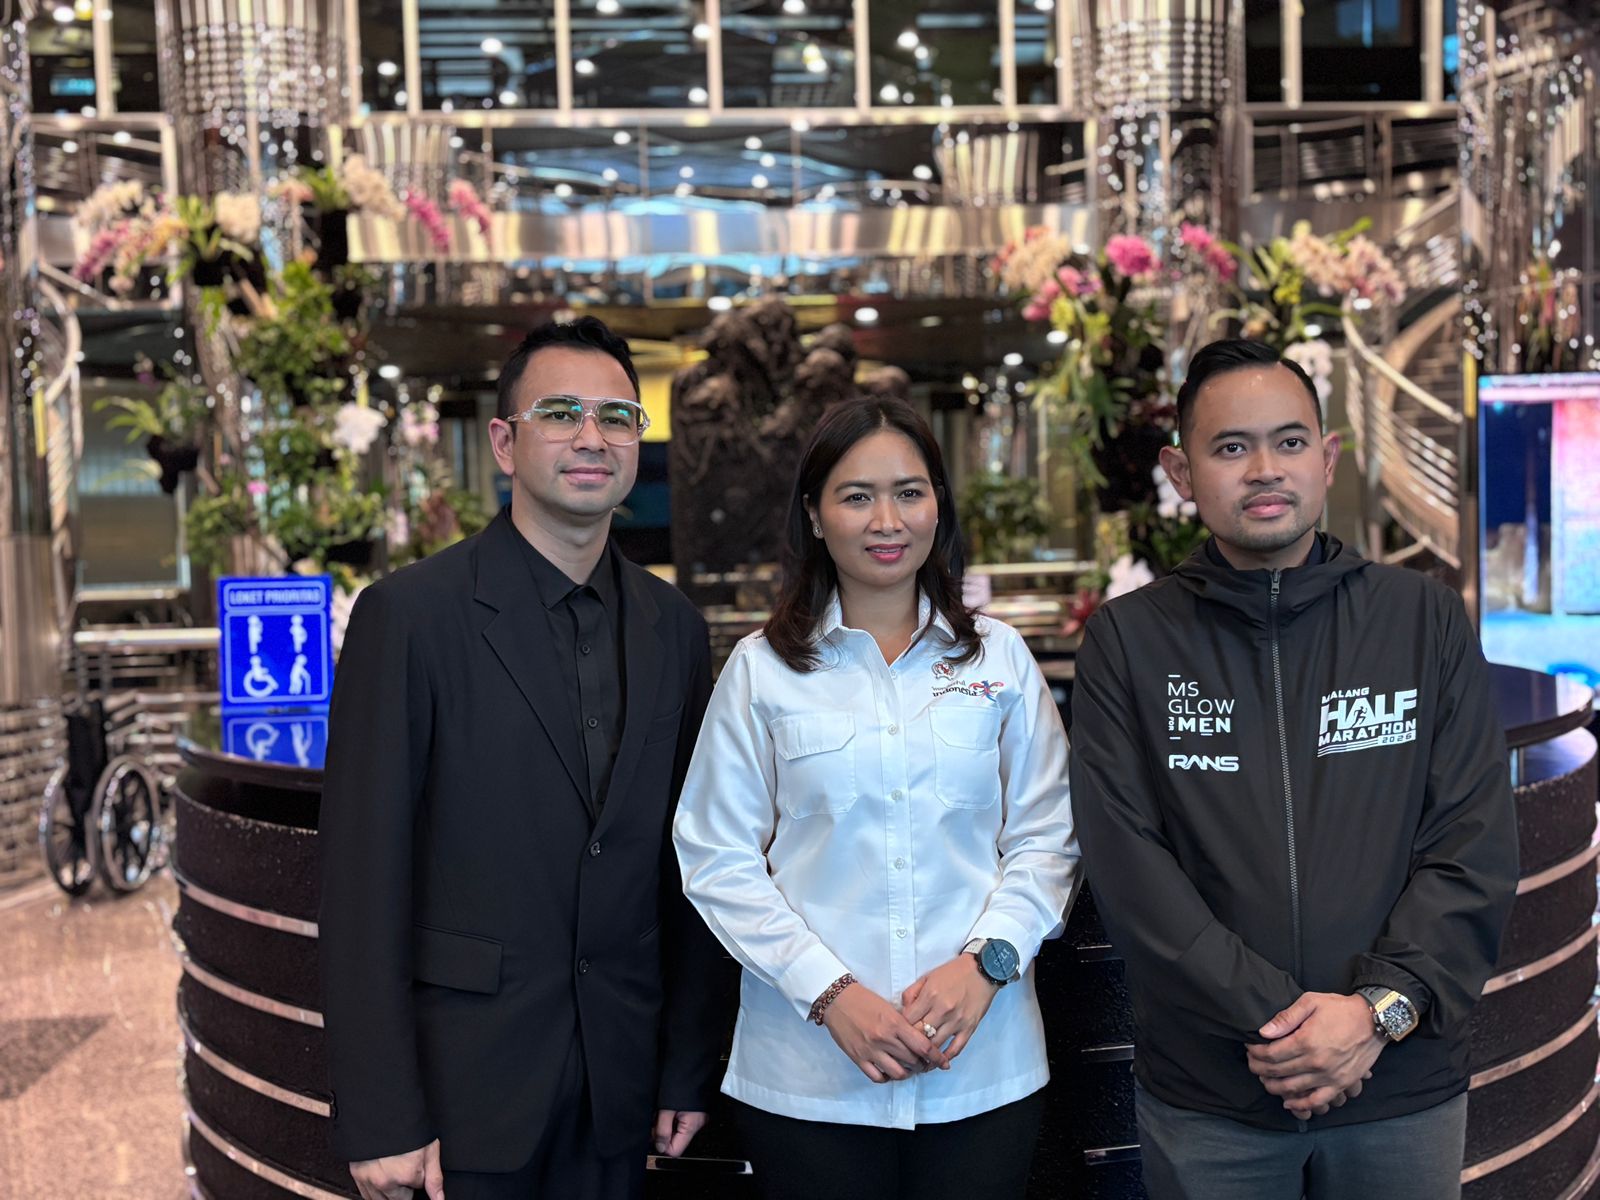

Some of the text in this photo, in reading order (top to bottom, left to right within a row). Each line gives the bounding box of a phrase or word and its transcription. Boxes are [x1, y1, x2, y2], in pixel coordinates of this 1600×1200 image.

[1168, 681, 1199, 697] MS
[1321, 686, 1370, 704] MALANG
[1168, 699, 1235, 715] GLOW
[1319, 688, 1418, 735] HALF
[1178, 717, 1231, 733] MEN
[1318, 718, 1417, 747] MARATHON
[1168, 754, 1240, 772] RANS
